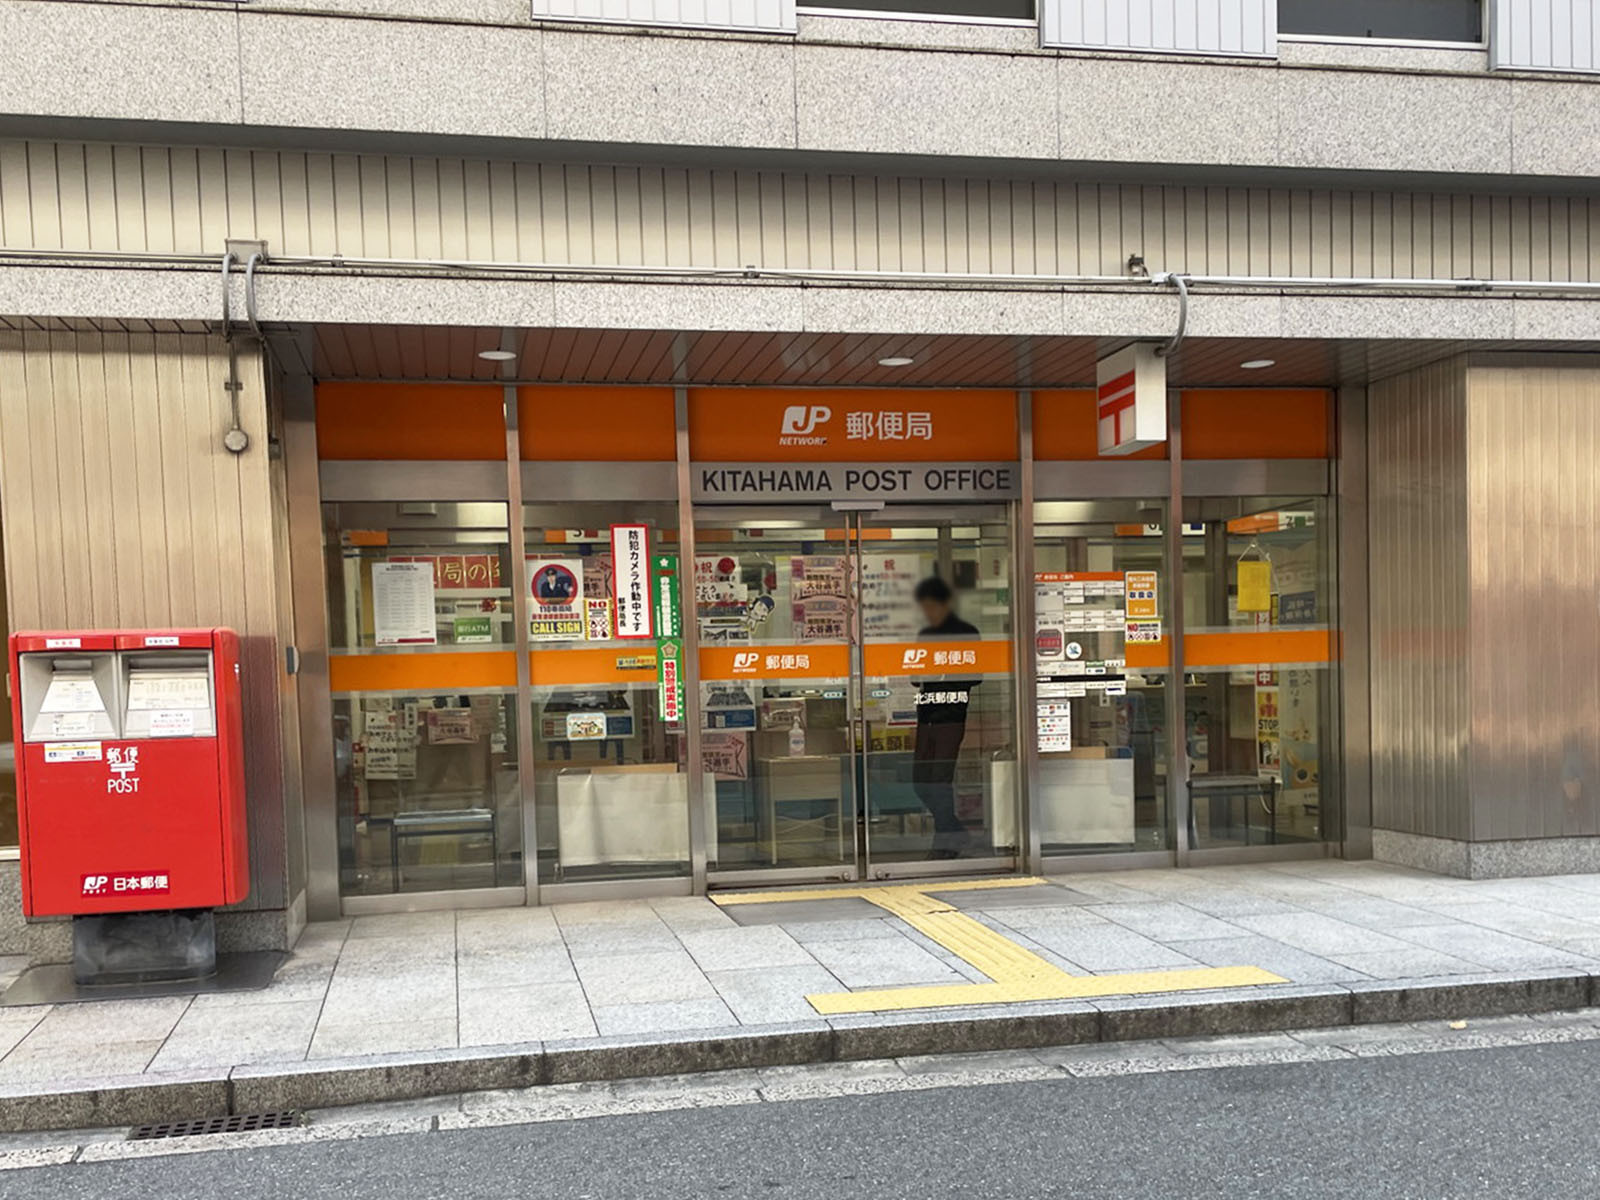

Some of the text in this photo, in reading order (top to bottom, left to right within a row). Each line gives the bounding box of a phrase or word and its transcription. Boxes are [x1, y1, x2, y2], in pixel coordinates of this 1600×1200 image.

[781, 405, 832, 435] JP
[846, 411, 933, 441] 郵便局
[702, 469, 1011, 492] KITAHAMA POST OFFICE
[628, 530, 642, 632] 防犯カメラ作動中です
[532, 621, 581, 635] CALL SIGN
[765, 654, 810, 670] 郵便局
[933, 650, 976, 666] 郵便局
[914, 691, 969, 706] 北浜郵便局
[1258, 718, 1279, 731] STOP
[106, 747, 139, 765] 郵便
[107, 778, 140, 793] POST
[114, 875, 168, 891] 日本郵便
